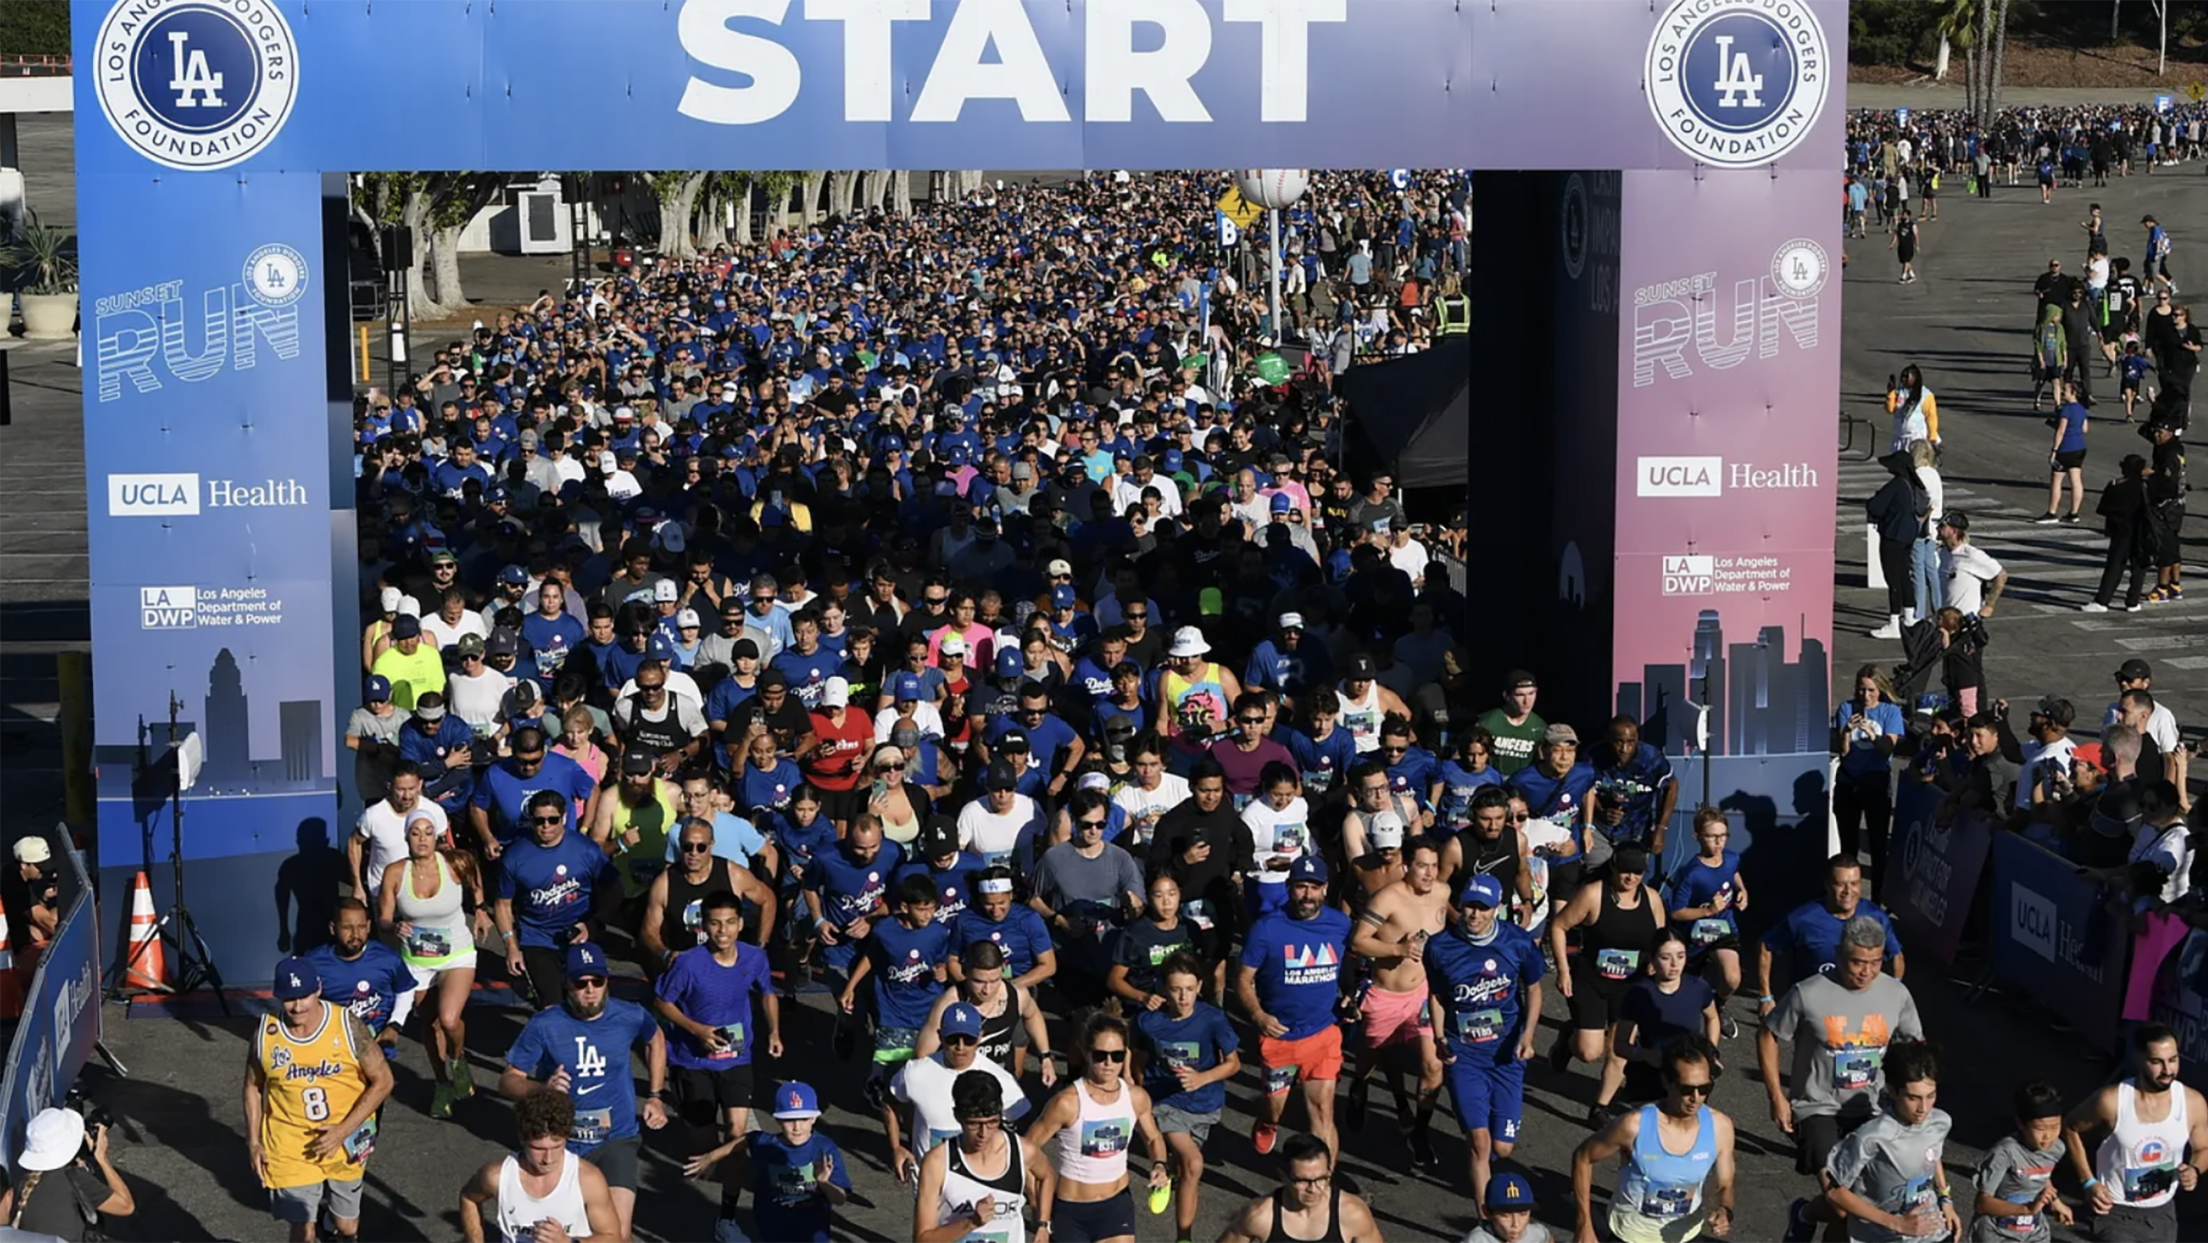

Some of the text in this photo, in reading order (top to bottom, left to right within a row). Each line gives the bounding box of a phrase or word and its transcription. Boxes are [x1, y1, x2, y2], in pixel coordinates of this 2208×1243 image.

[108, 41, 127, 82] LOS
[168, 32, 223, 107] LA
[677, 0, 1346, 125] START
[1659, 43, 1676, 82] LOS
[1714, 36, 1763, 107] LA
[124, 108, 272, 156] FOUNDATION
[1671, 107, 1804, 154] FOUNDATION
[1222, 217, 1237, 246] B
[266, 262, 286, 288] LA
[1792, 256, 1808, 280] LA
[95, 279, 183, 315] SUNSET
[1634, 271, 1717, 304] SUNSET
[96, 283, 300, 402] RUN
[1634, 275, 1819, 387] RUN
[1650, 463, 1818, 488] UCLA Health
[121, 479, 308, 507] UCLA Health
[1665, 558, 1691, 574] LA
[1714, 556, 1778, 570] Los Angeles
[1714, 568, 1790, 581] Department of
[197, 587, 267, 602] Los Angeles
[1665, 576, 1712, 593] DWP
[1714, 580, 1790, 592] Water & Power
[143, 590, 171, 606] LA
[197, 600, 282, 615] Department of
[144, 610, 194, 627] DWP
[197, 612, 282, 626] Water & Power
[1492, 734, 1535, 753] ANCERS
[531, 877, 581, 906] Dodgers
[842, 883, 886, 912] Dodgers
[934, 898, 967, 924] dgers
[2017, 896, 2051, 944] UCLA
[580, 949, 594, 964] LA
[289, 972, 302, 988] LA
[887, 961, 929, 983] Dodgers
[1454, 974, 1512, 1003] Dodgers
[271, 1046, 292, 1070] Los
[574, 1036, 607, 1078] LA
[285, 1058, 343, 1083] Angeles
[302, 1086, 330, 1122] 8
[576, 1130, 595, 1140] 111
[951, 1199, 1019, 1217] VAOR
